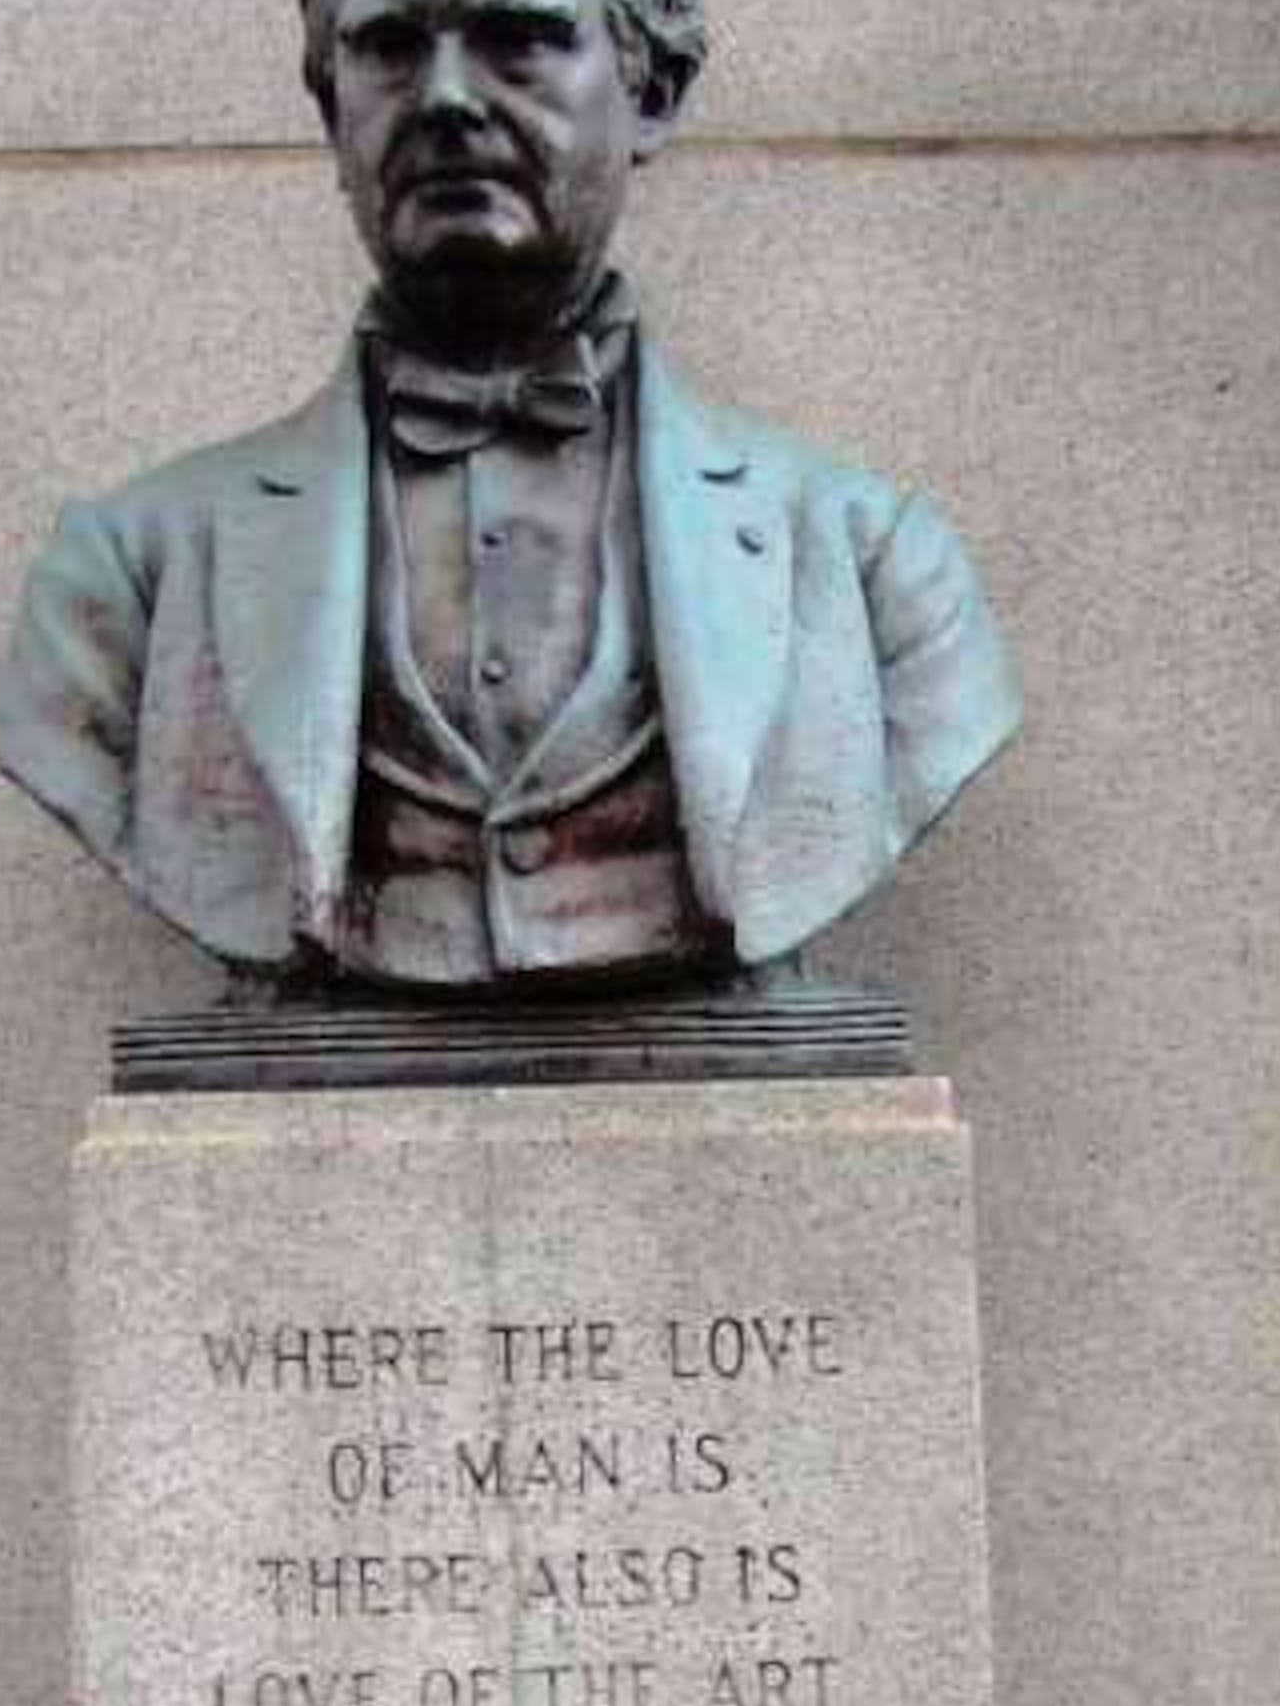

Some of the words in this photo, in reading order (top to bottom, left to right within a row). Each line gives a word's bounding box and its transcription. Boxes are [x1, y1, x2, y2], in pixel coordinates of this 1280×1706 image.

[202, 1327, 450, 1391] WHERE
[488, 1321, 622, 1383] THE
[667, 1315, 844, 1379] LOVE
[328, 1441, 412, 1503] OF
[457, 1435, 620, 1497] MAN
[666, 1433, 730, 1494] IS
[257, 1555, 480, 1617] THERE
[524, 1547, 703, 1609] ALSO
[734, 1545, 801, 1605] IS
